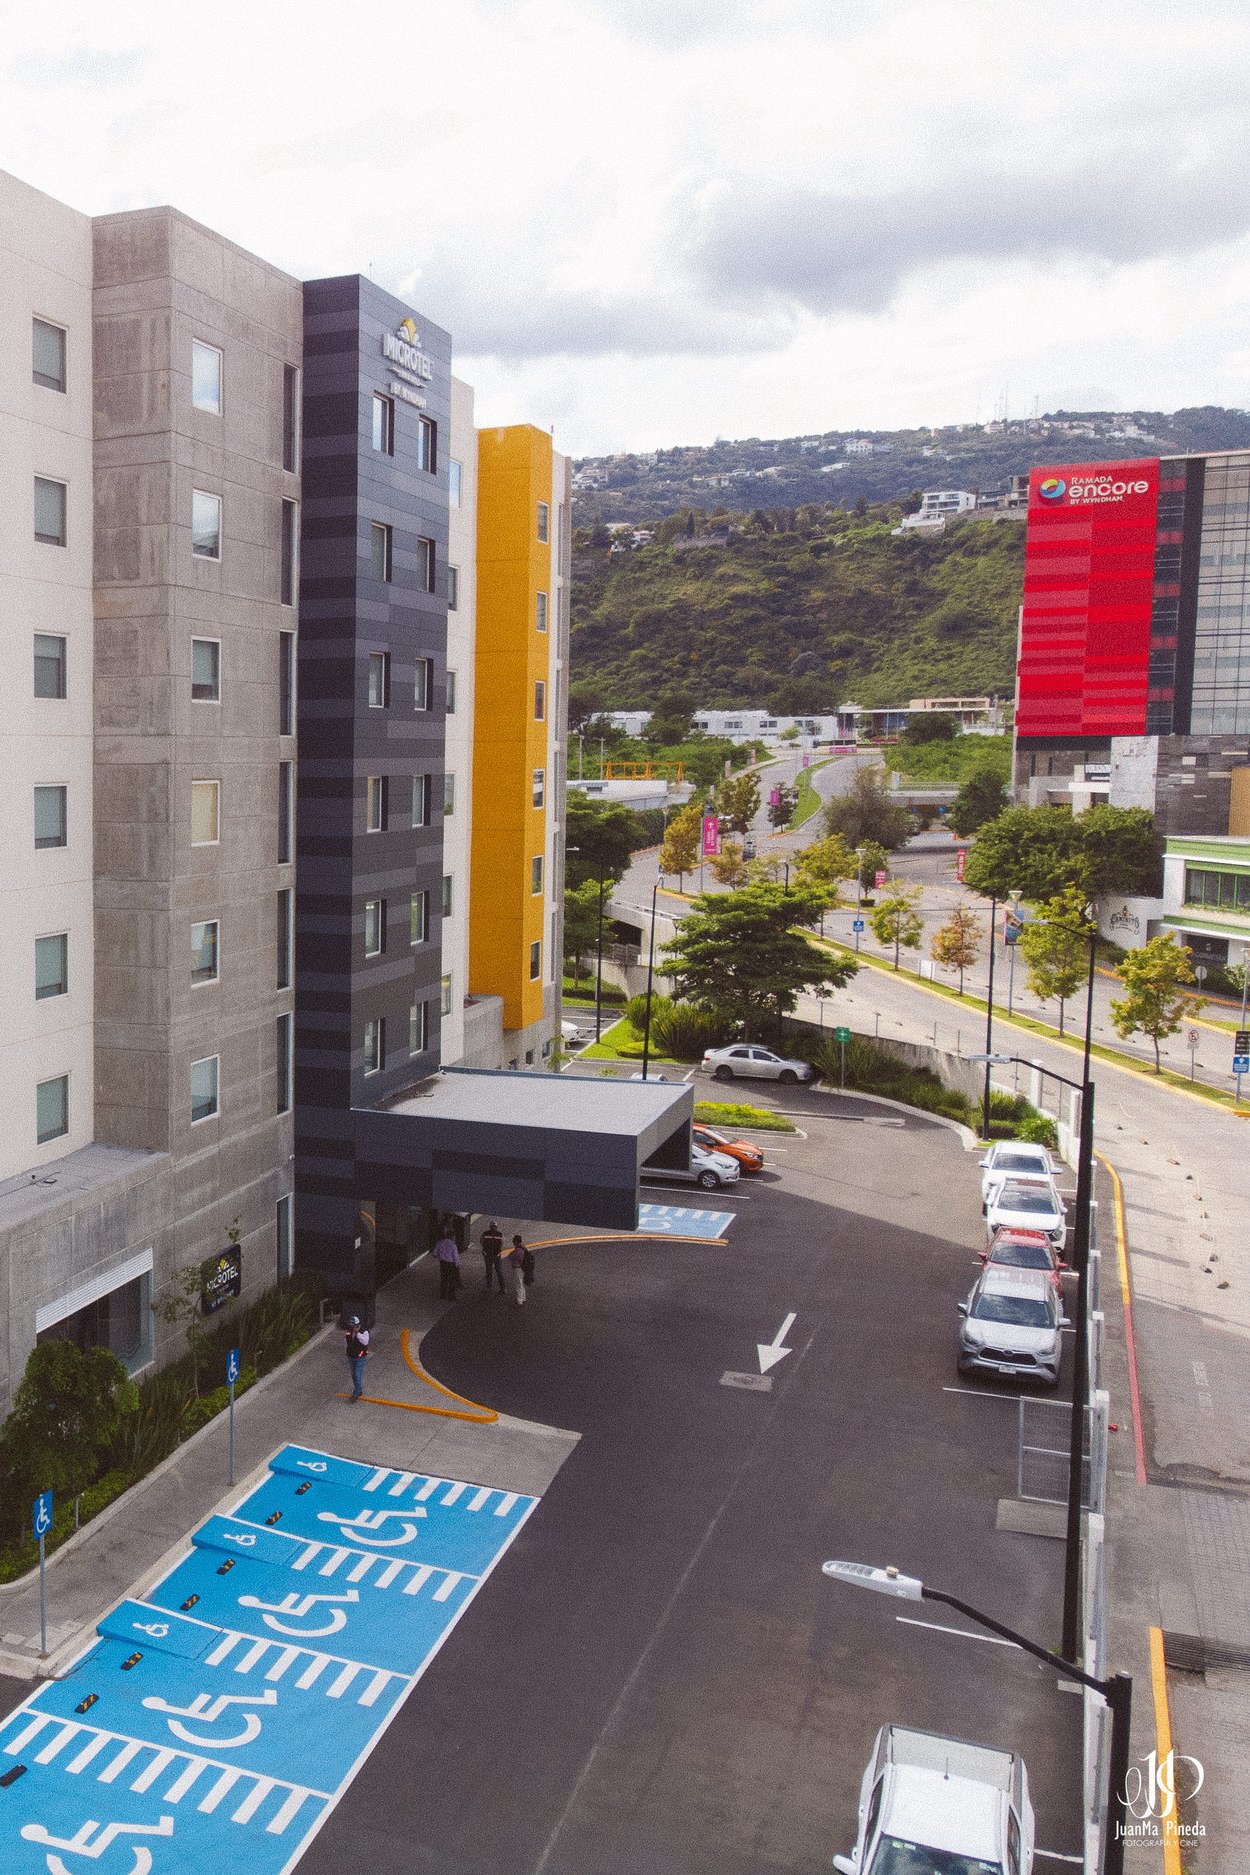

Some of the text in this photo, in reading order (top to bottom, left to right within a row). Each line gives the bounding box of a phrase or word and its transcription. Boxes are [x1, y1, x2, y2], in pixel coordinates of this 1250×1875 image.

[382, 333, 433, 381] MICROTEL
[1071, 476, 1113, 485] RAMADA
[1068, 480, 1149, 498] encore
[1082, 496, 1123, 504] WYNDHAM
